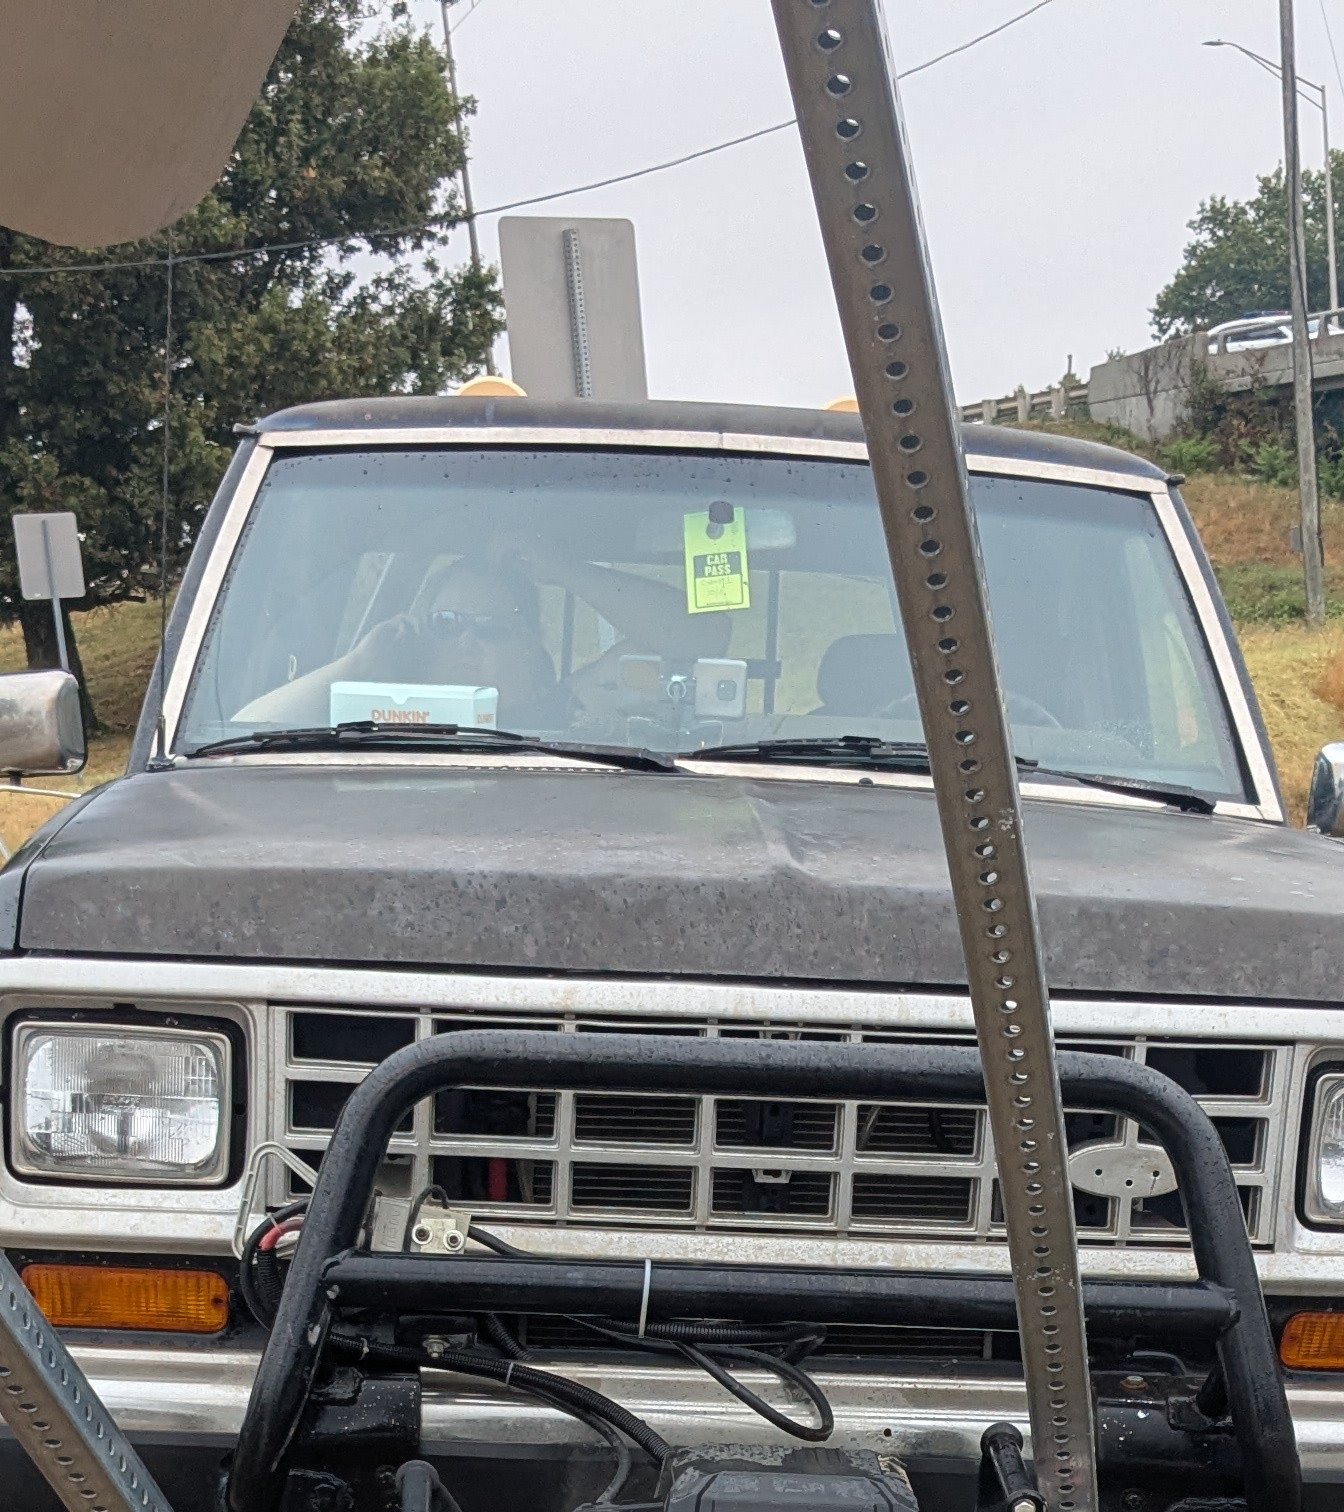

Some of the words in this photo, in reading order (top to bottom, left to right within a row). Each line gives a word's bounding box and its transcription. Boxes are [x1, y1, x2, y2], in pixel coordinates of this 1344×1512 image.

[706, 553, 728, 565] CAR
[704, 564, 731, 577] PASS
[371, 709, 430, 723] DUNKIN'
